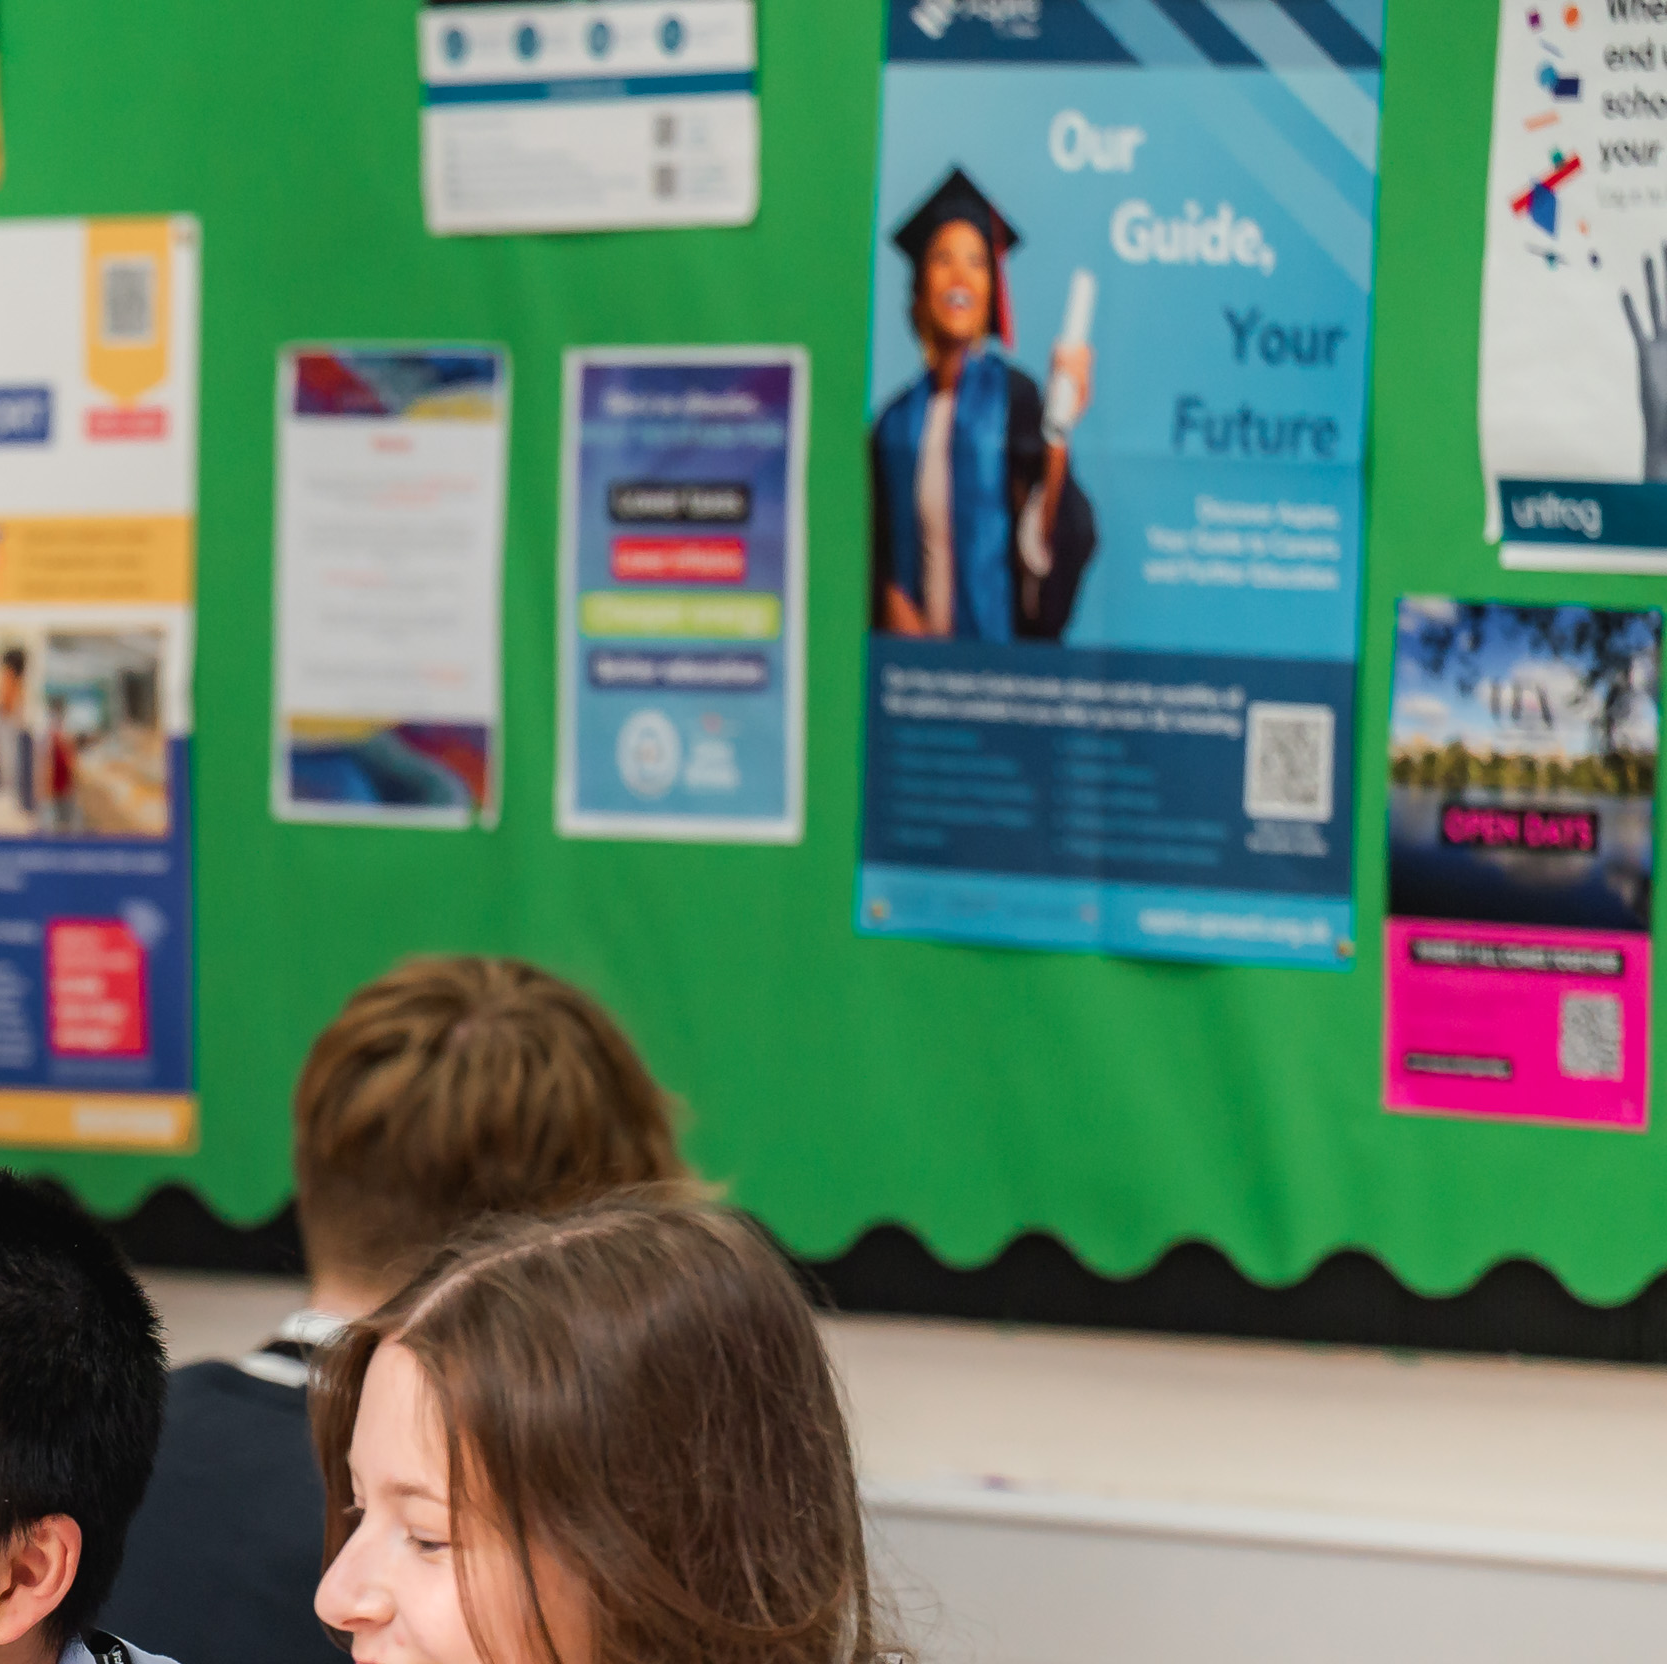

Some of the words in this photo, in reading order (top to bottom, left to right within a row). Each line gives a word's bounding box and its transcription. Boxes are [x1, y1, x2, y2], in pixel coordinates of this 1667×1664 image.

[1049, 108, 1144, 173] Our
[1599, 137, 1659, 173] your
[1109, 199, 1276, 276] Guide,
[1224, 306, 1346, 367] Your
[1173, 395, 1339, 459] Future
[1443, 807, 1519, 844] OPEN
[1523, 811, 1593, 851] DAYS
